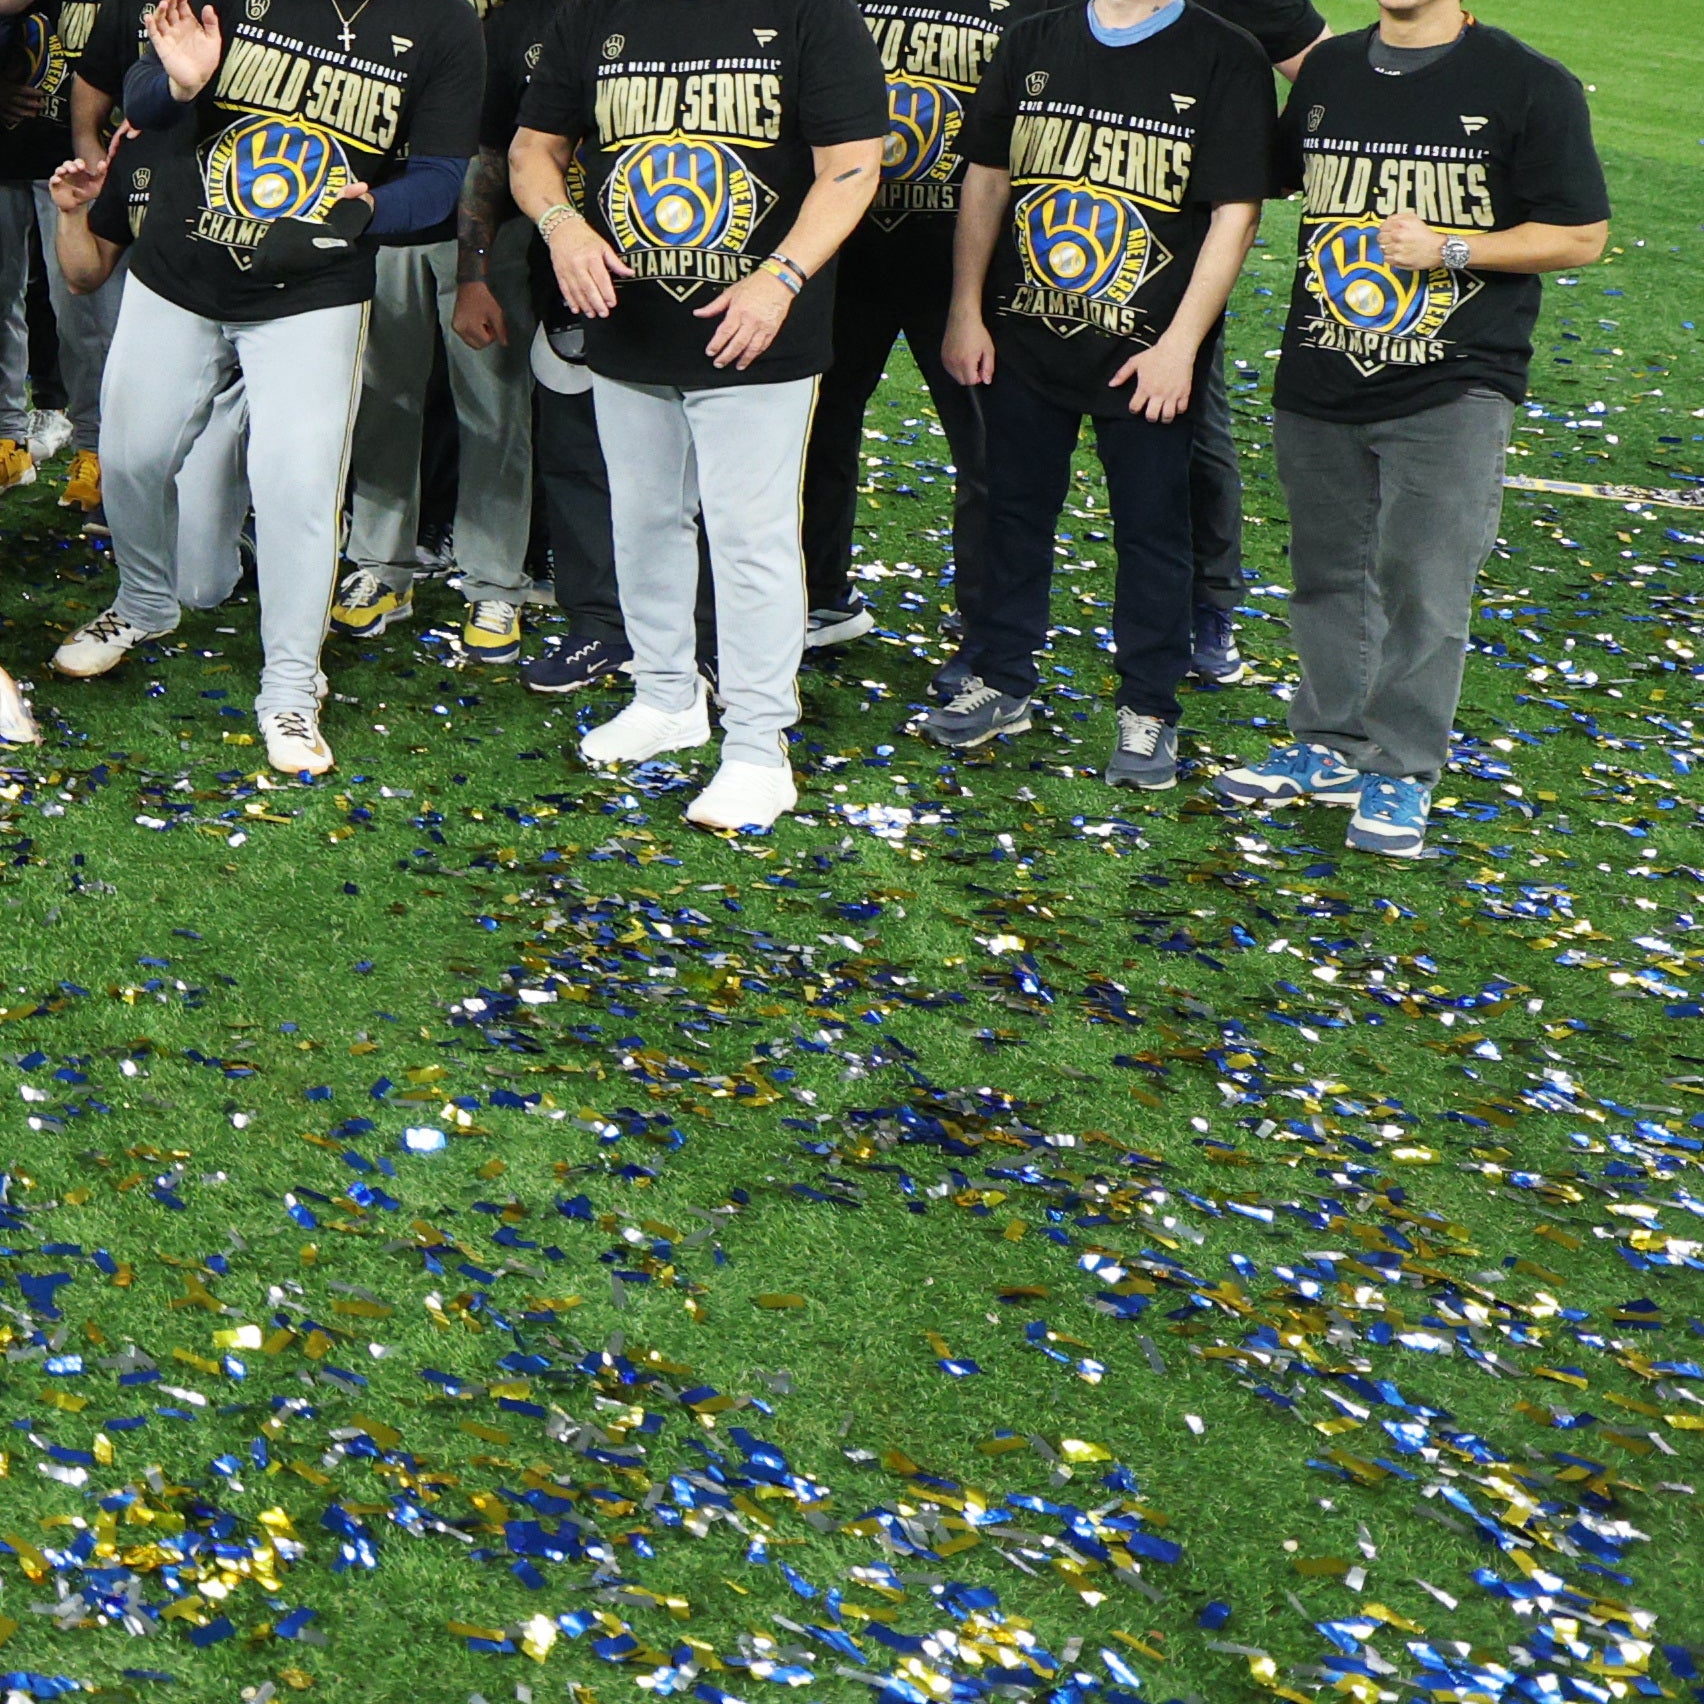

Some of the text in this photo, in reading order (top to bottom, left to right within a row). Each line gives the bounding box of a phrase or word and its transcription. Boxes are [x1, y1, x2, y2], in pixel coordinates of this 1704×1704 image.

[236, 22, 409, 83] 2026 MAJOR LEAGUE BASEBALL
[598, 59, 782, 77] 2026 MAJOR LEAGUE BASEBALL
[218, 37, 405, 151] WORLD SERIES
[595, 73, 783, 146] WORLD SERIES
[206, 128, 239, 210] MILWAUKEE
[1010, 115, 1192, 205] WORLD SERIES
[1379, 159, 1494, 228] SERIES
[727, 170, 753, 253] BREWERS
[1106, 228, 1146, 306] BREWERS
[1011, 284, 1136, 335] CHAMPIONS
[1305, 317, 1445, 363] CHAMPIONS
